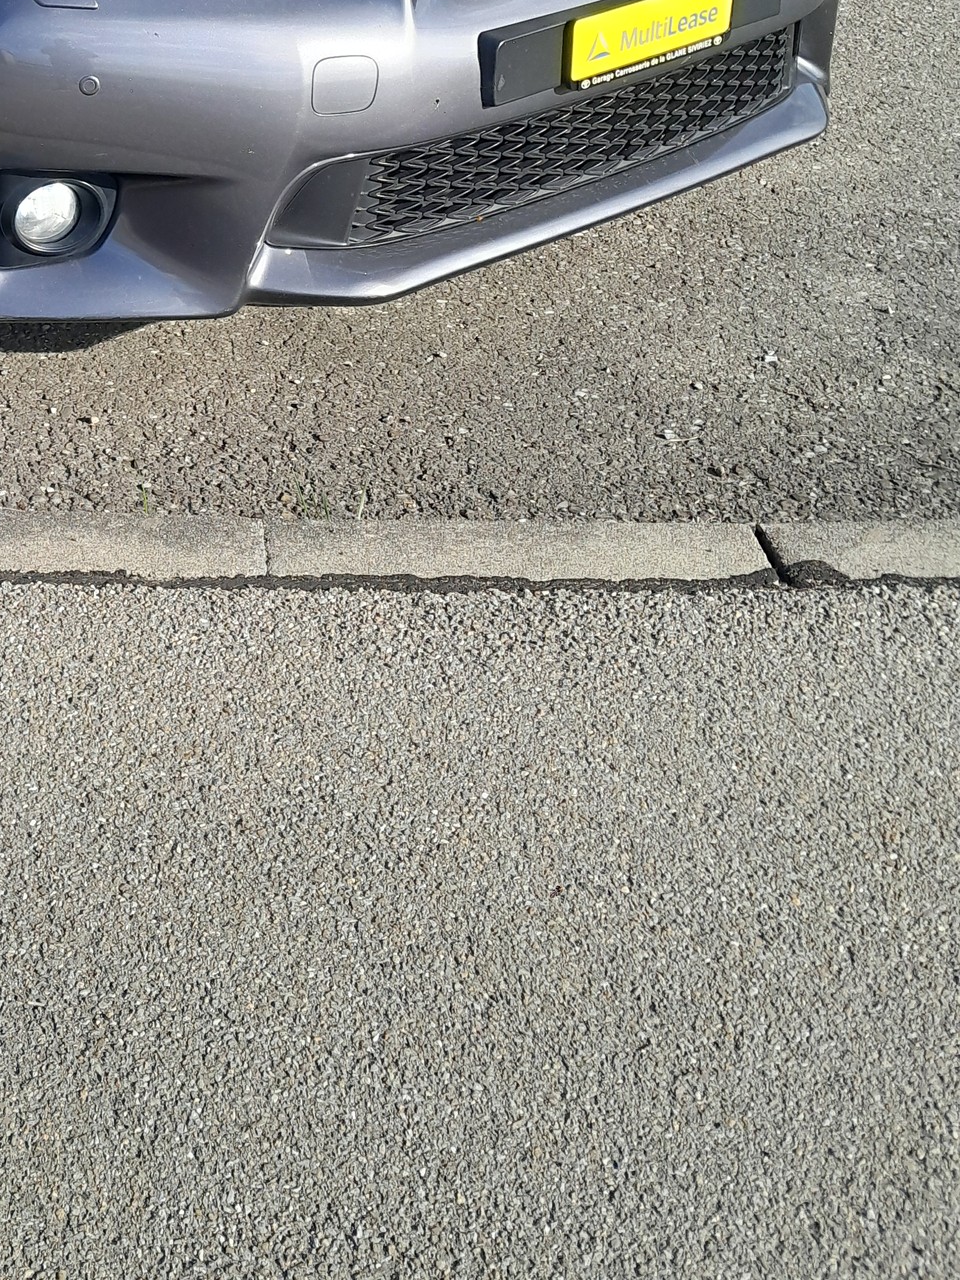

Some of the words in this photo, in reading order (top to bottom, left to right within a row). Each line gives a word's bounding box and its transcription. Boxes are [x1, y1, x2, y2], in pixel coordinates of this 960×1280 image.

[620, 6, 718, 51] MultiLease
[591, 73, 615, 86] Garage
[650, 58, 659, 66] de
